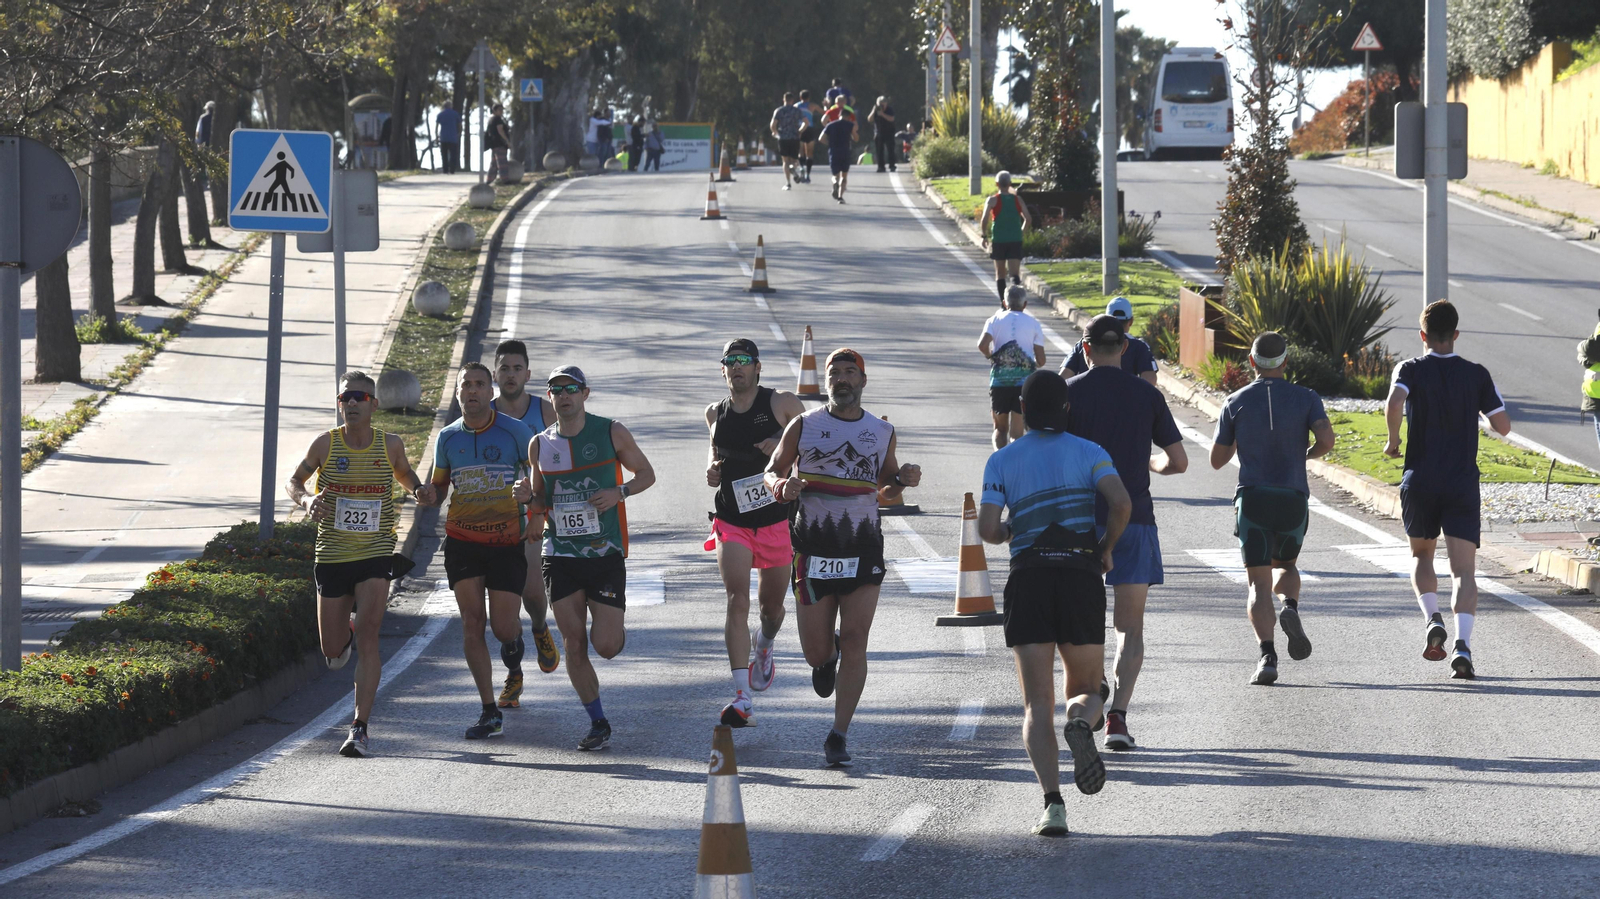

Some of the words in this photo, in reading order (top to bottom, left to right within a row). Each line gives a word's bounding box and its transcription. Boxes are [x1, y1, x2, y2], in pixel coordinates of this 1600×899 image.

[460, 467, 486, 480] TRAIL
[328, 483, 387, 494] ESTEPONA
[744, 484, 769, 503] 134
[750, 498, 772, 509] EVOS
[343, 510, 368, 525] 232
[562, 513, 584, 528] 165
[819, 560, 844, 573] 210
